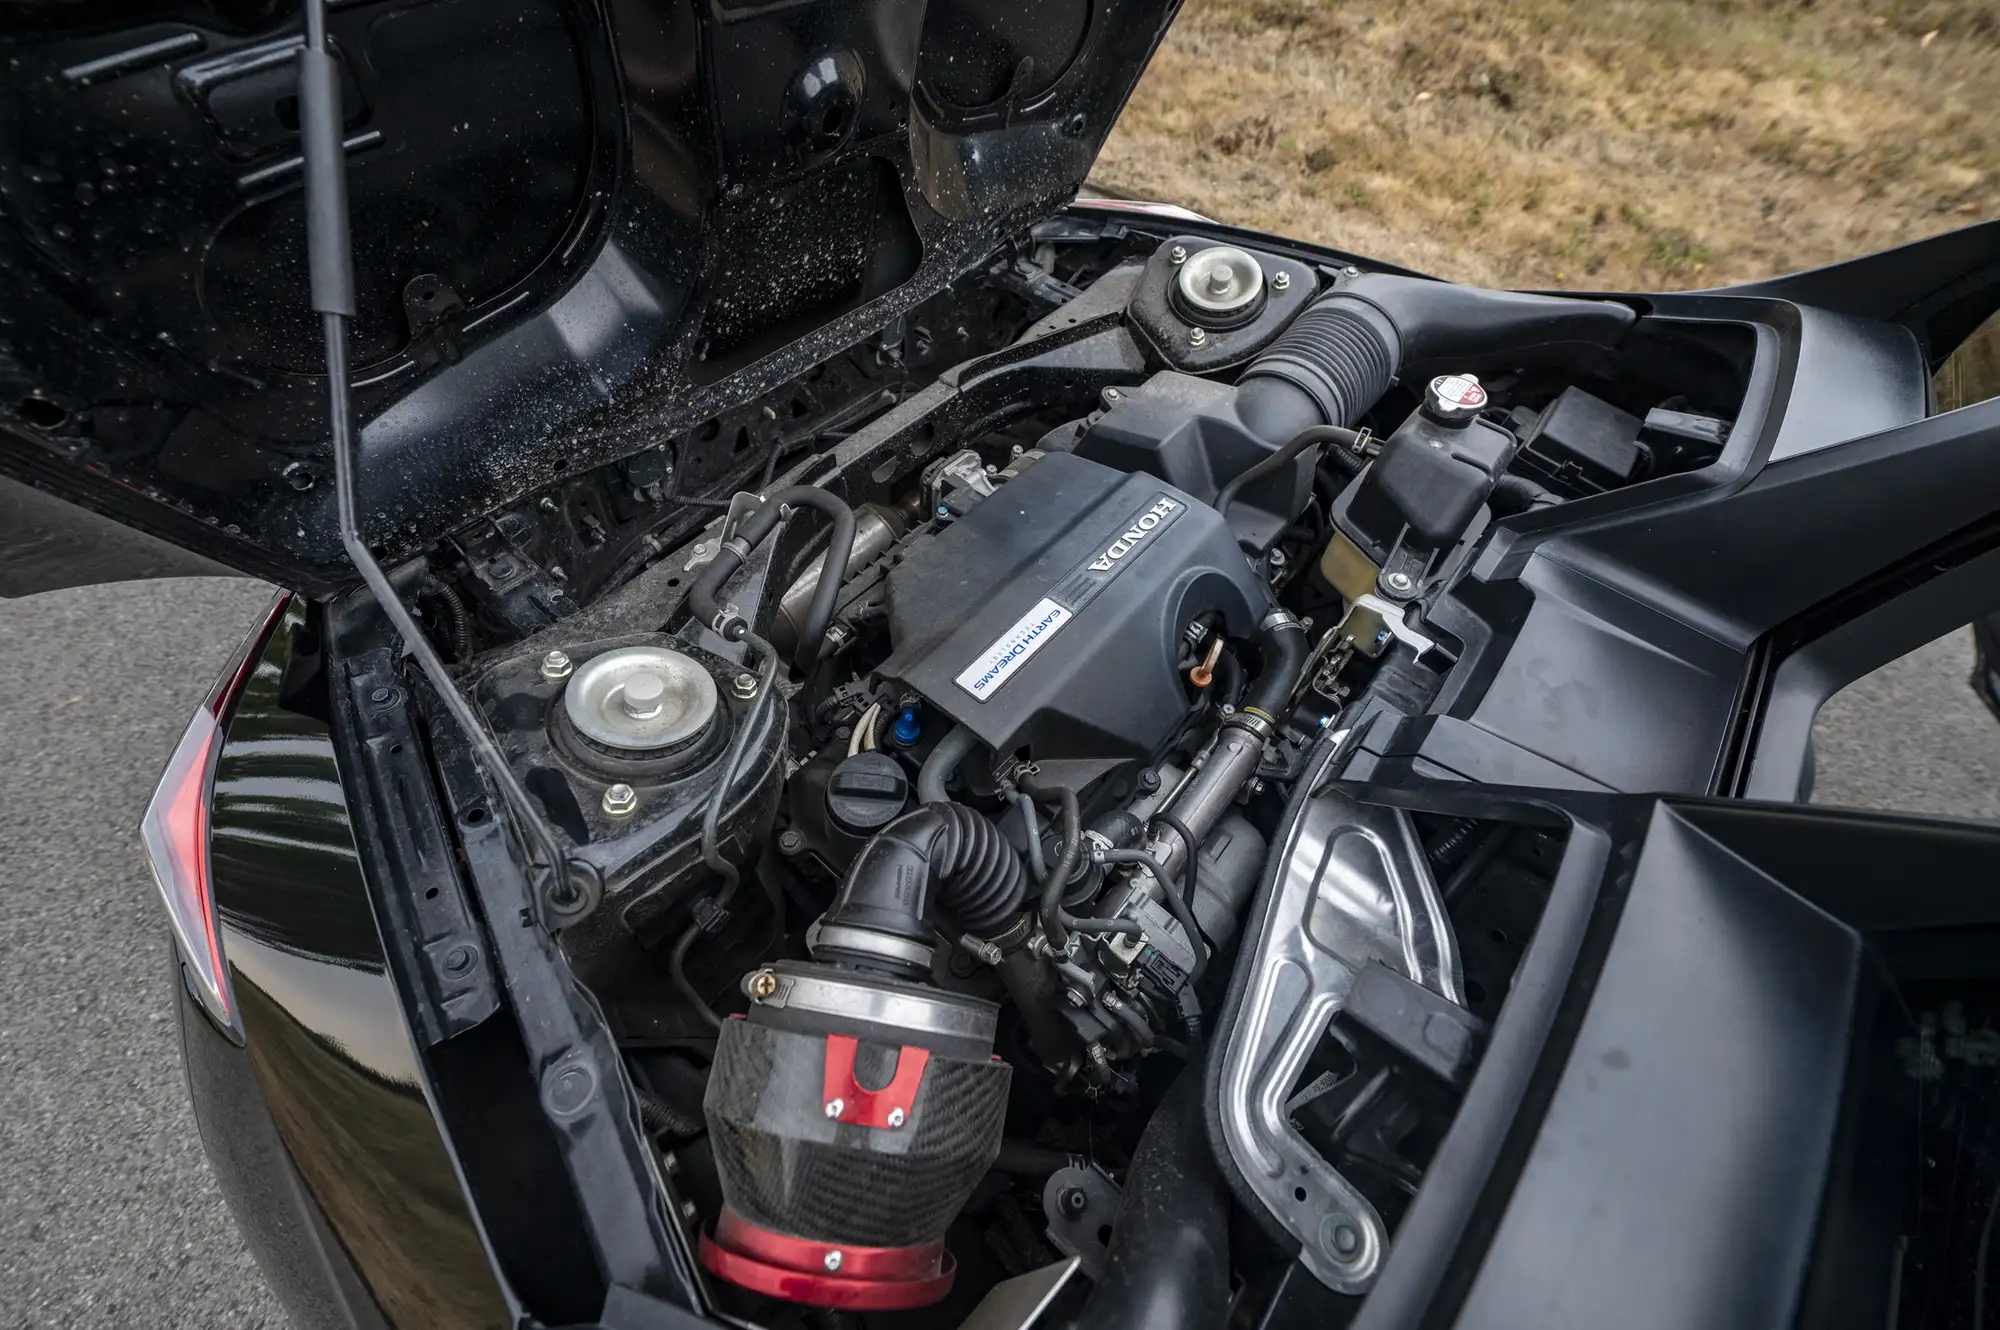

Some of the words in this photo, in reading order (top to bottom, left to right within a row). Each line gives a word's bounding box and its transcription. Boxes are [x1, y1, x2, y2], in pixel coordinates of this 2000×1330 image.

[1087, 498, 1177, 571] HONDA
[989, 623, 1035, 664] TECHNOLOGY
[1022, 609, 1061, 645] EARTH
[974, 643, 1027, 691] DREAMS
